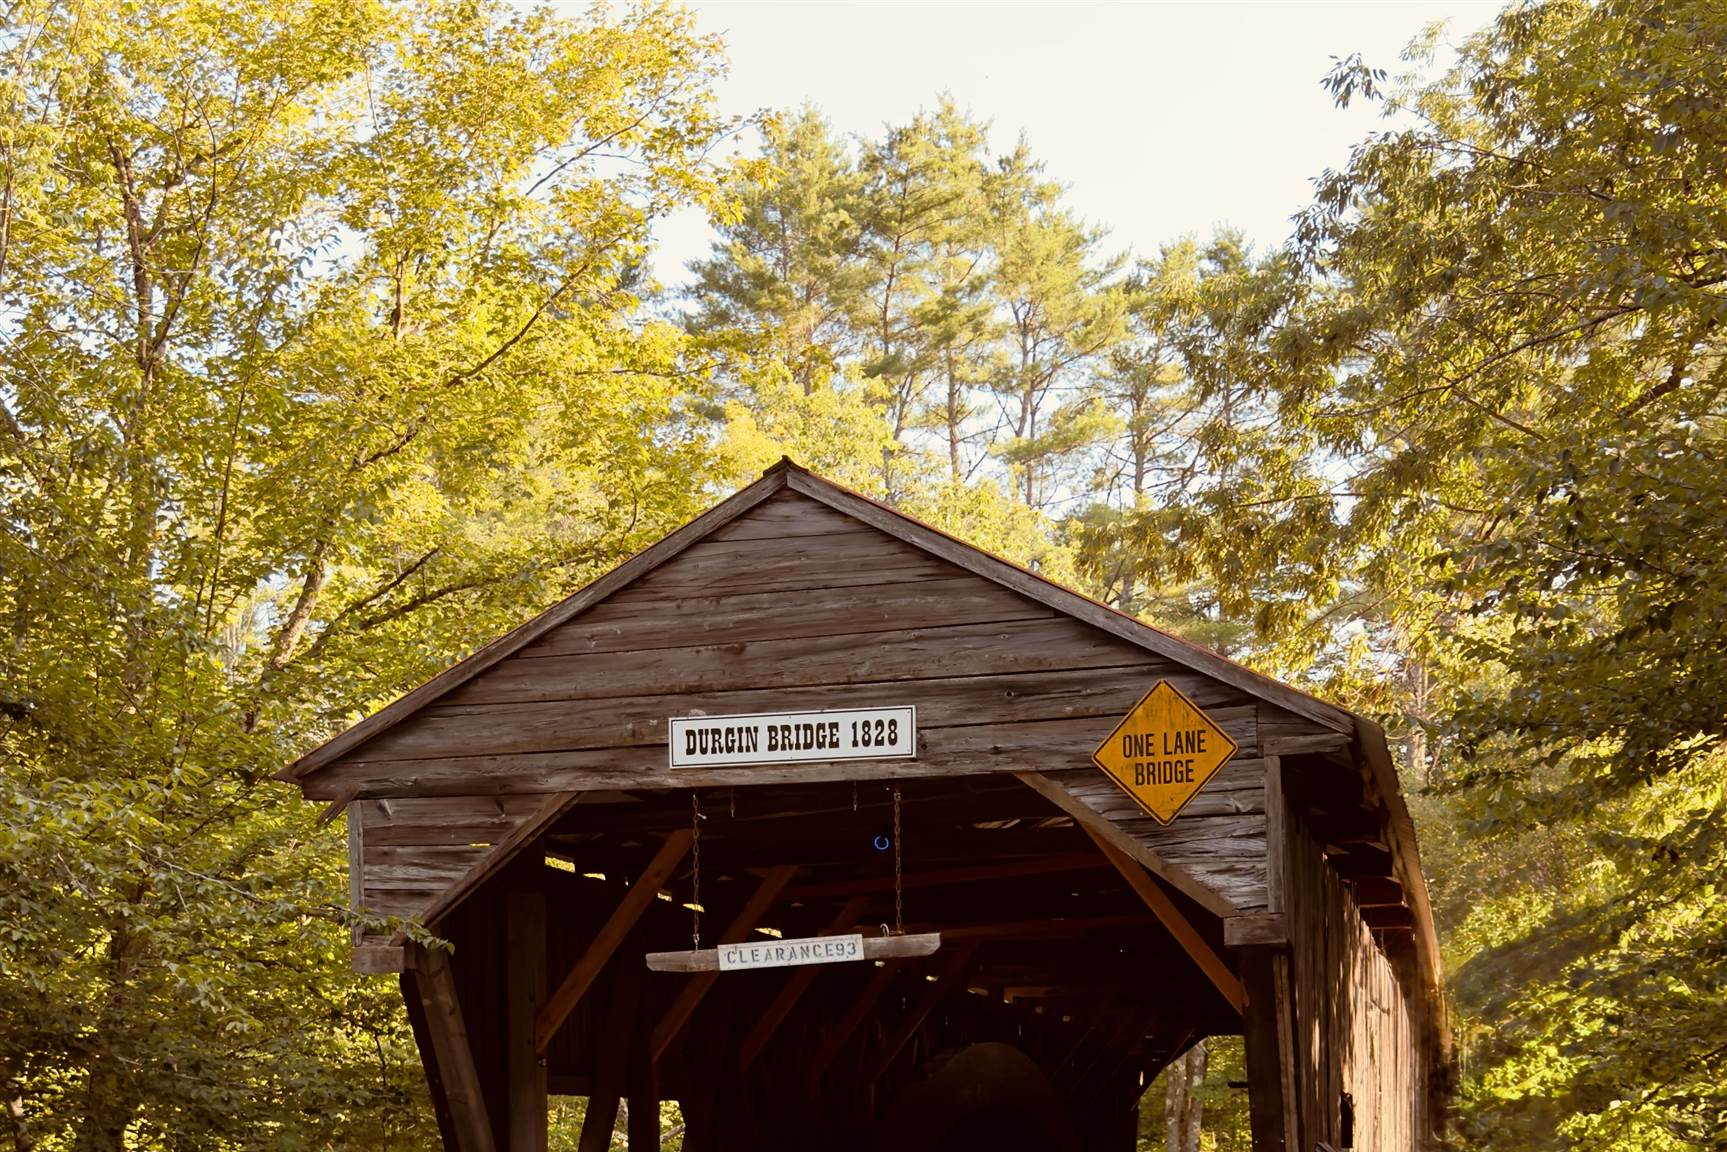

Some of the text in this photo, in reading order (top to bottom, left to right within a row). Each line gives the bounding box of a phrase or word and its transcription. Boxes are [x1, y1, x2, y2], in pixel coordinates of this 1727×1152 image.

[685, 718, 898, 756] DURGIN BRIDGE 1828
[1122, 729, 1207, 759] ONE LANE
[1135, 759, 1195, 786] BRIDGE
